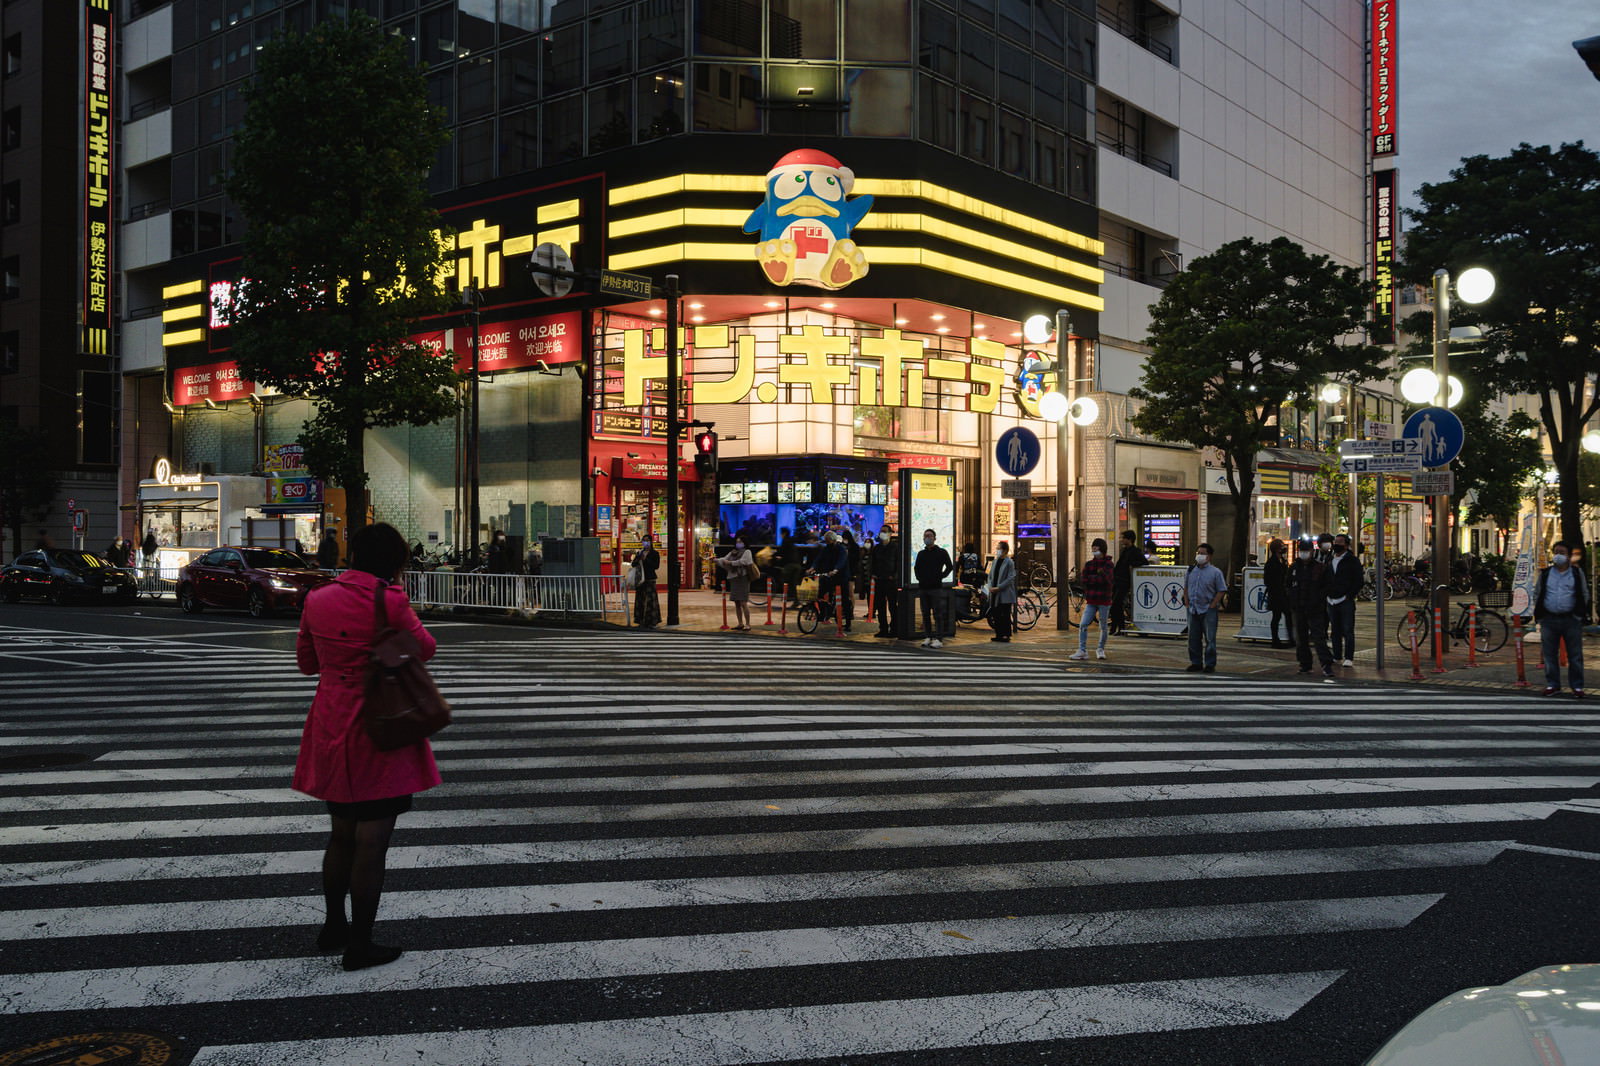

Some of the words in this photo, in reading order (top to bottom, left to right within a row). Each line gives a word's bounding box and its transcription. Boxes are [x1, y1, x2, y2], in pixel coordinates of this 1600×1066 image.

[1376, 135, 1392, 146] 6F
[90, 221, 106, 313] 伊勢佐木町店
[602, 274, 651, 295] 伊勢佐木町3丁目
[421, 339, 442, 352] Shop
[466, 332, 511, 348] WELCOME
[182, 372, 211, 385] WELCOME
[655, 406, 685, 418] 驚安堂
[284, 484, 303, 497] 宝くじ
